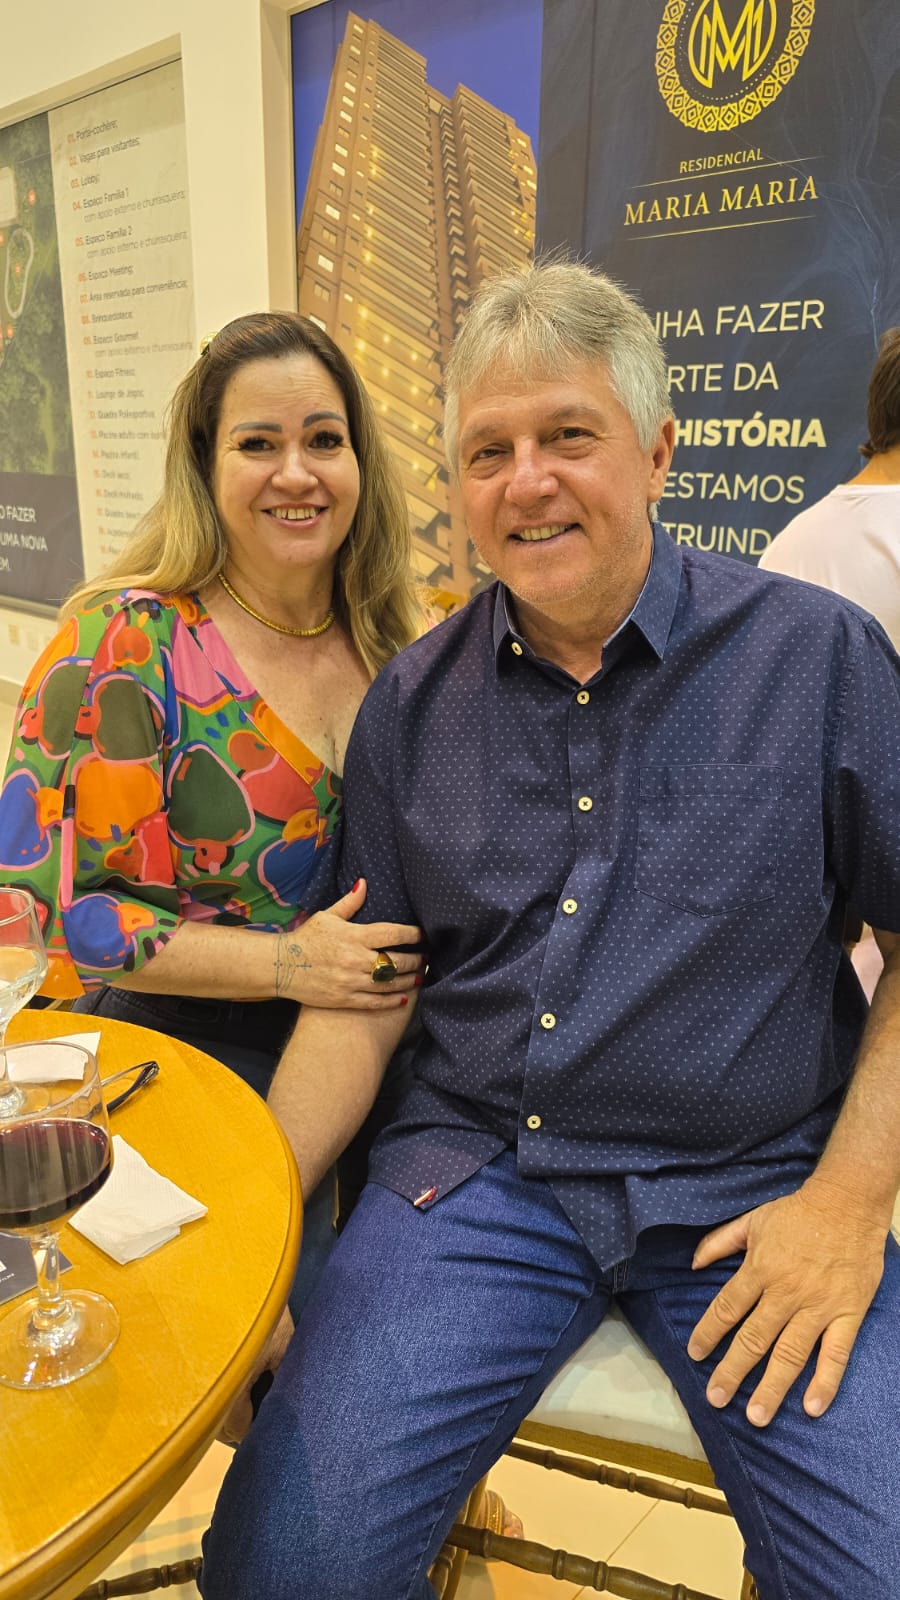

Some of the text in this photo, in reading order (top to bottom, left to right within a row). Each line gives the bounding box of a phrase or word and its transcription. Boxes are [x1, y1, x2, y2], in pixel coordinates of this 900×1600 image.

[79, 151, 96, 163] Vagas
[97, 147, 110, 159] para
[679, 148, 764, 174] RESIDENCIAL
[624, 175, 818, 226] MARIA MARIA
[131, 286, 145, 297] para
[716, 300, 825, 335] FAZER
[667, 361, 779, 393] RTE DA
[674, 410, 827, 448] HISTÓRIA
[661, 471, 805, 504] ESTAMOS
[6, 505, 37, 523] FAZER
[21, 533, 49, 552] NOVA
[661, 521, 774, 556] TRUIND
